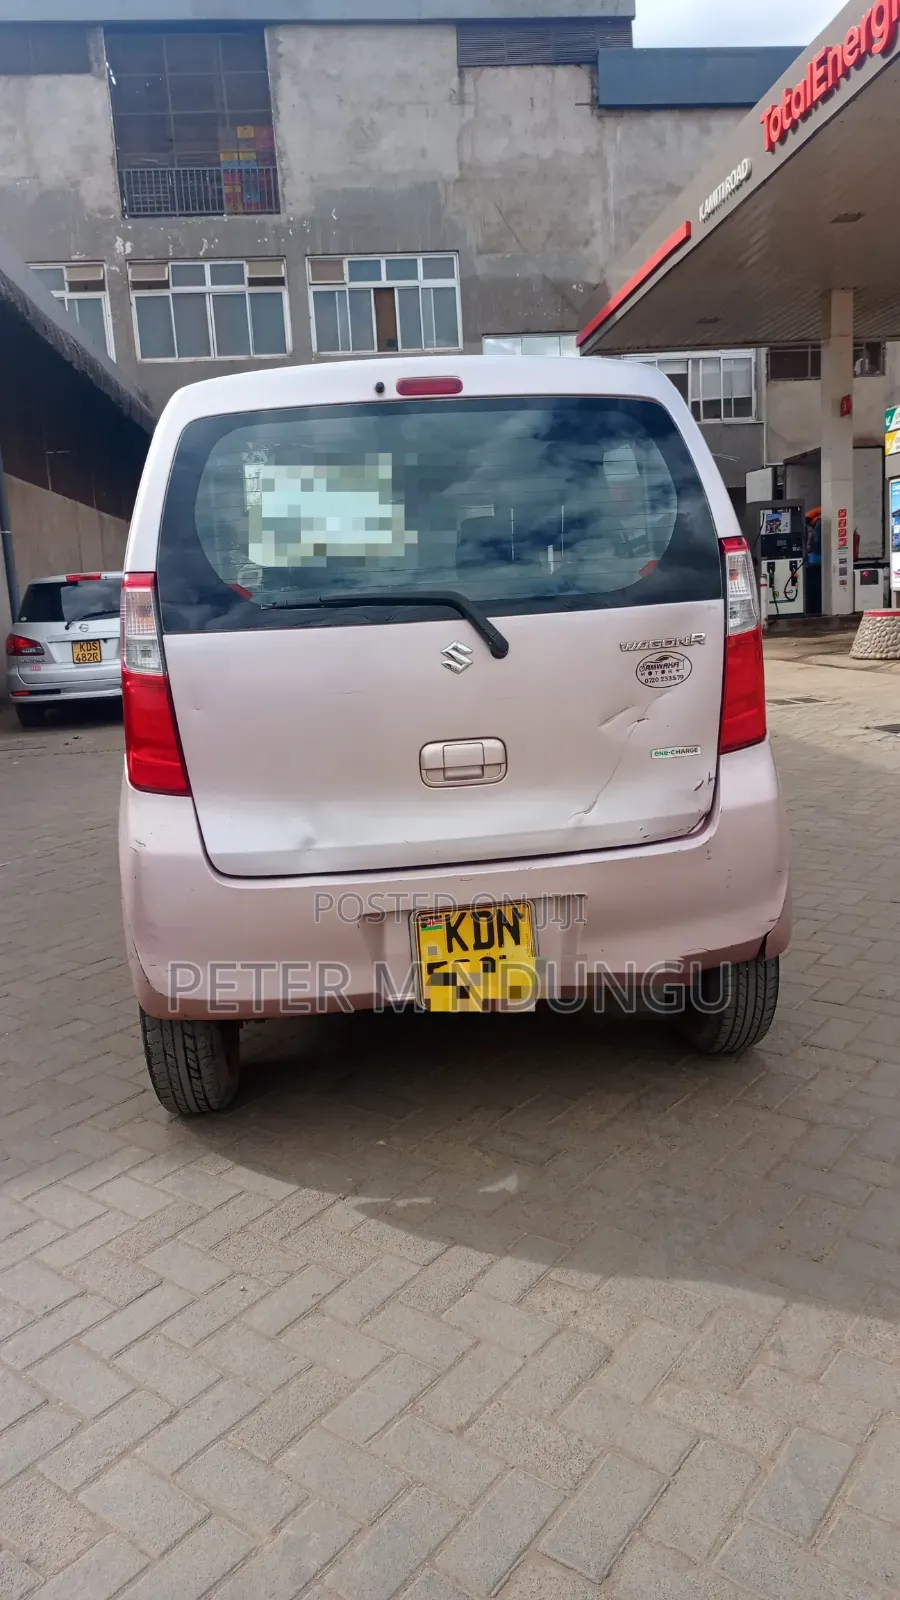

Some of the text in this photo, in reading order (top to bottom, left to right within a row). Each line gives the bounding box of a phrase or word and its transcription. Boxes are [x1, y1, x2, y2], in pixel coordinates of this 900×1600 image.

[699, 158, 751, 222] KAMITI ROAD
[76, 652, 98, 663] 482R
[80, 641, 98, 652] KDS
[445, 907, 521, 953] KDN
